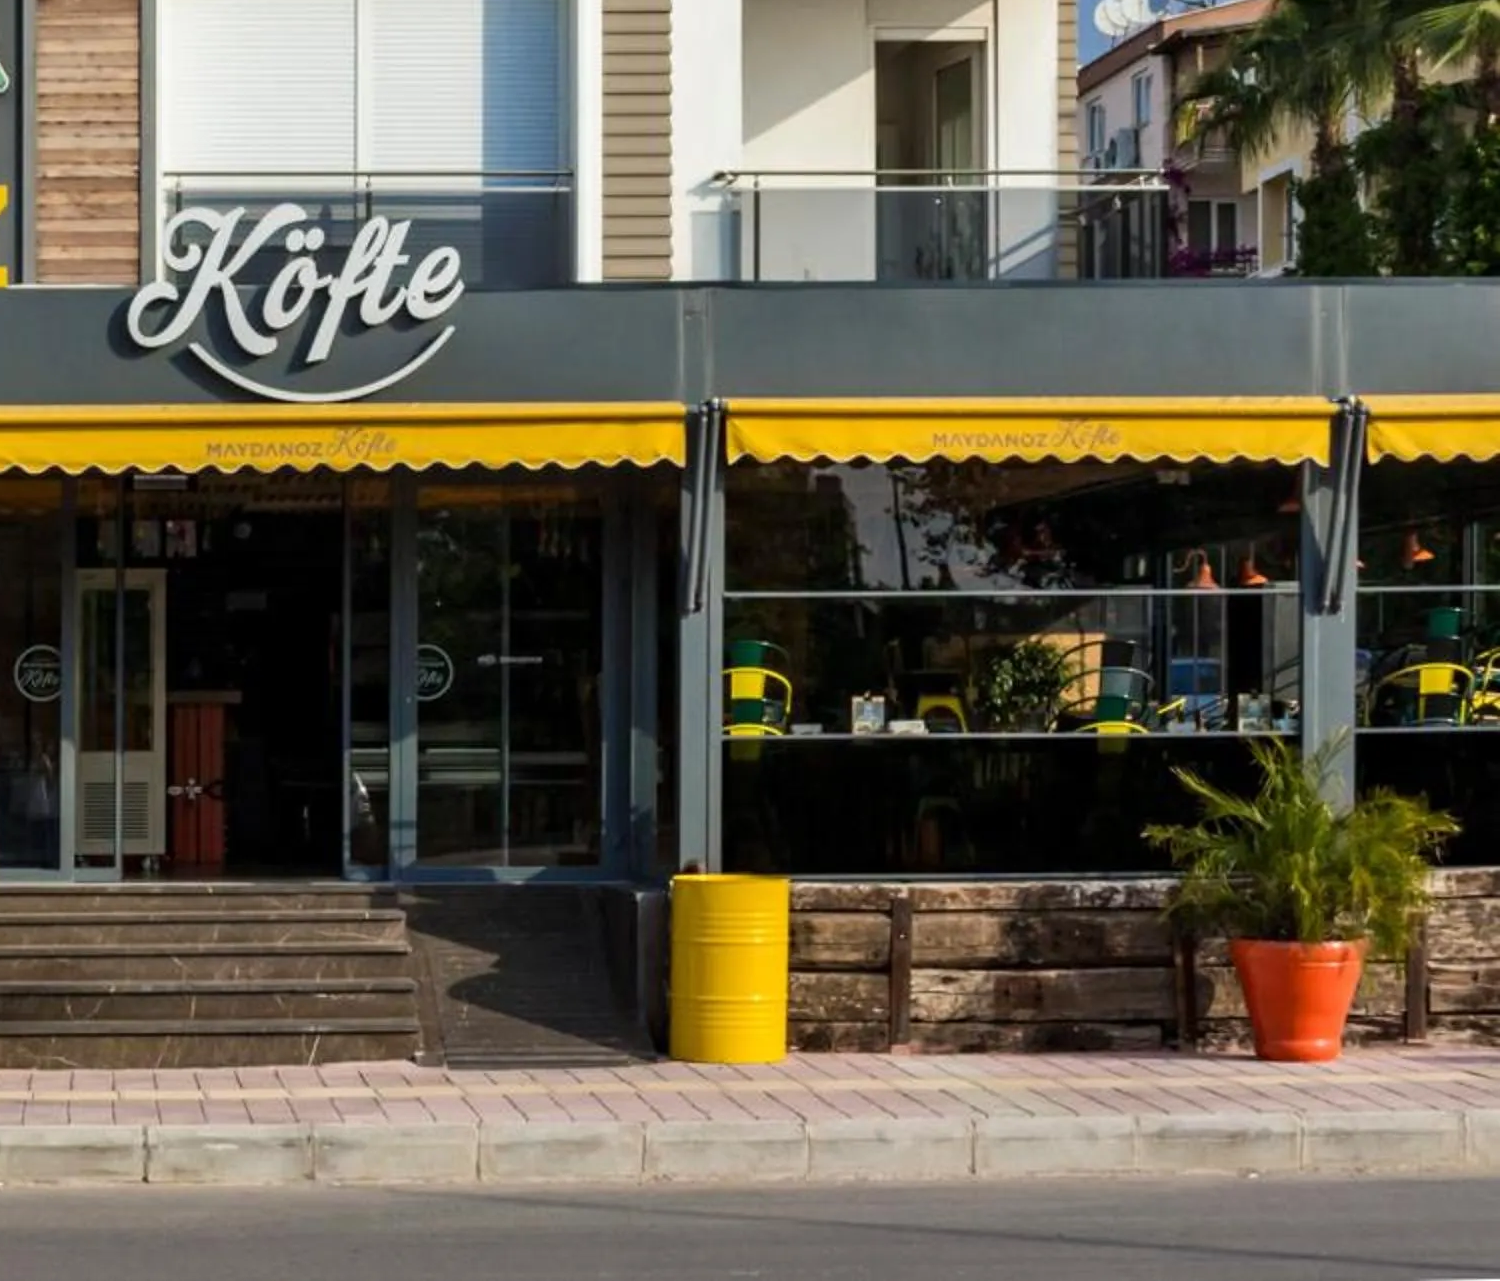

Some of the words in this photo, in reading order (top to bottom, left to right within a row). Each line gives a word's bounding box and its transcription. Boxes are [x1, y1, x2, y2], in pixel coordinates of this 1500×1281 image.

[127, 202, 465, 364] Köfte
[932, 432, 1048, 448] MAYDANOZ
[206, 441, 323, 458] MAYDANOZ
